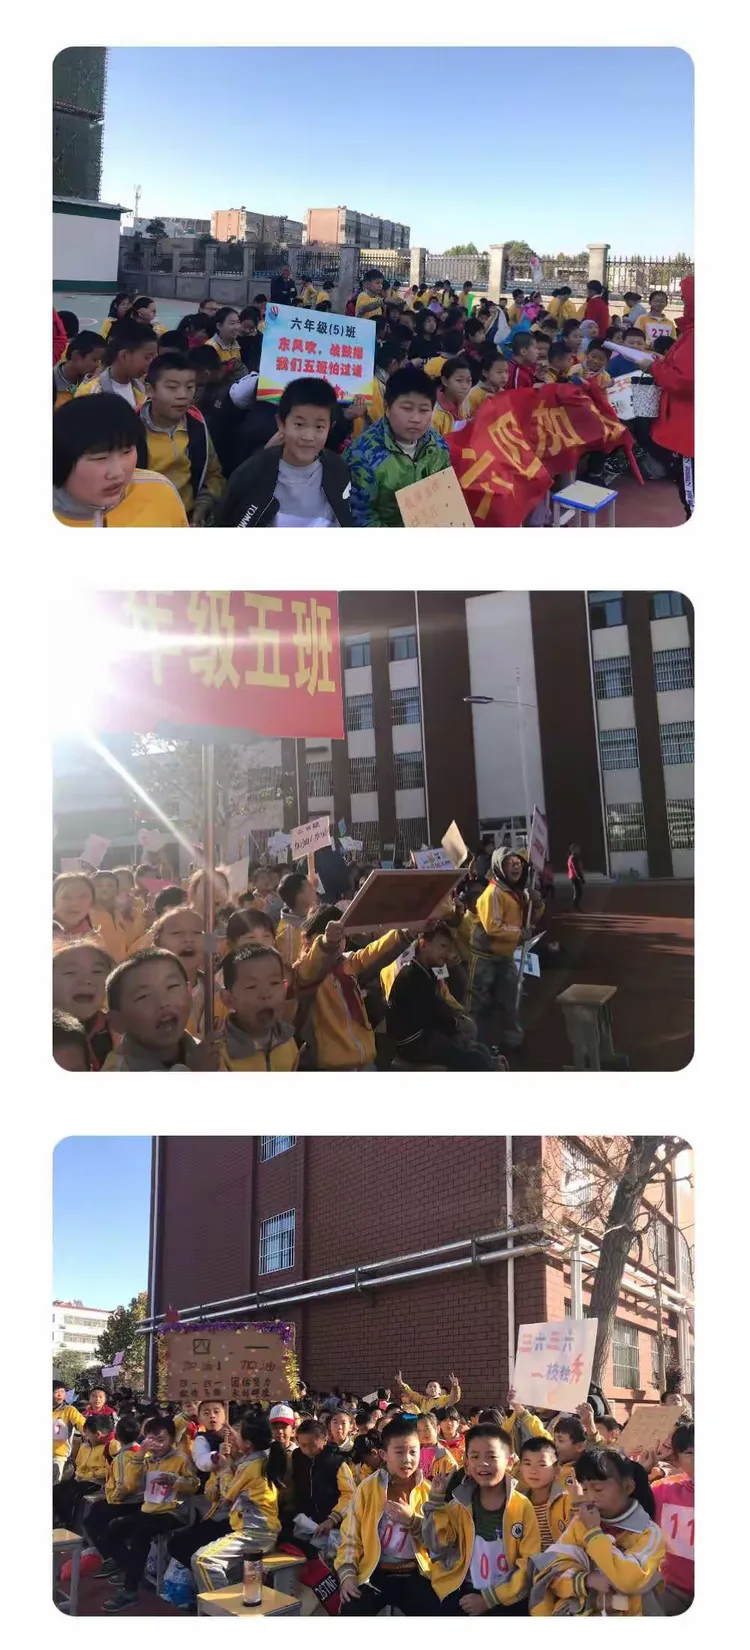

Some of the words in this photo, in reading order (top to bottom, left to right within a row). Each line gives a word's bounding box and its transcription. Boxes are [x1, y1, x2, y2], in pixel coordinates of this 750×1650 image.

[290, 317, 356, 338] 六年级(5)班
[519, 1327, 575, 1353] 三六三六
